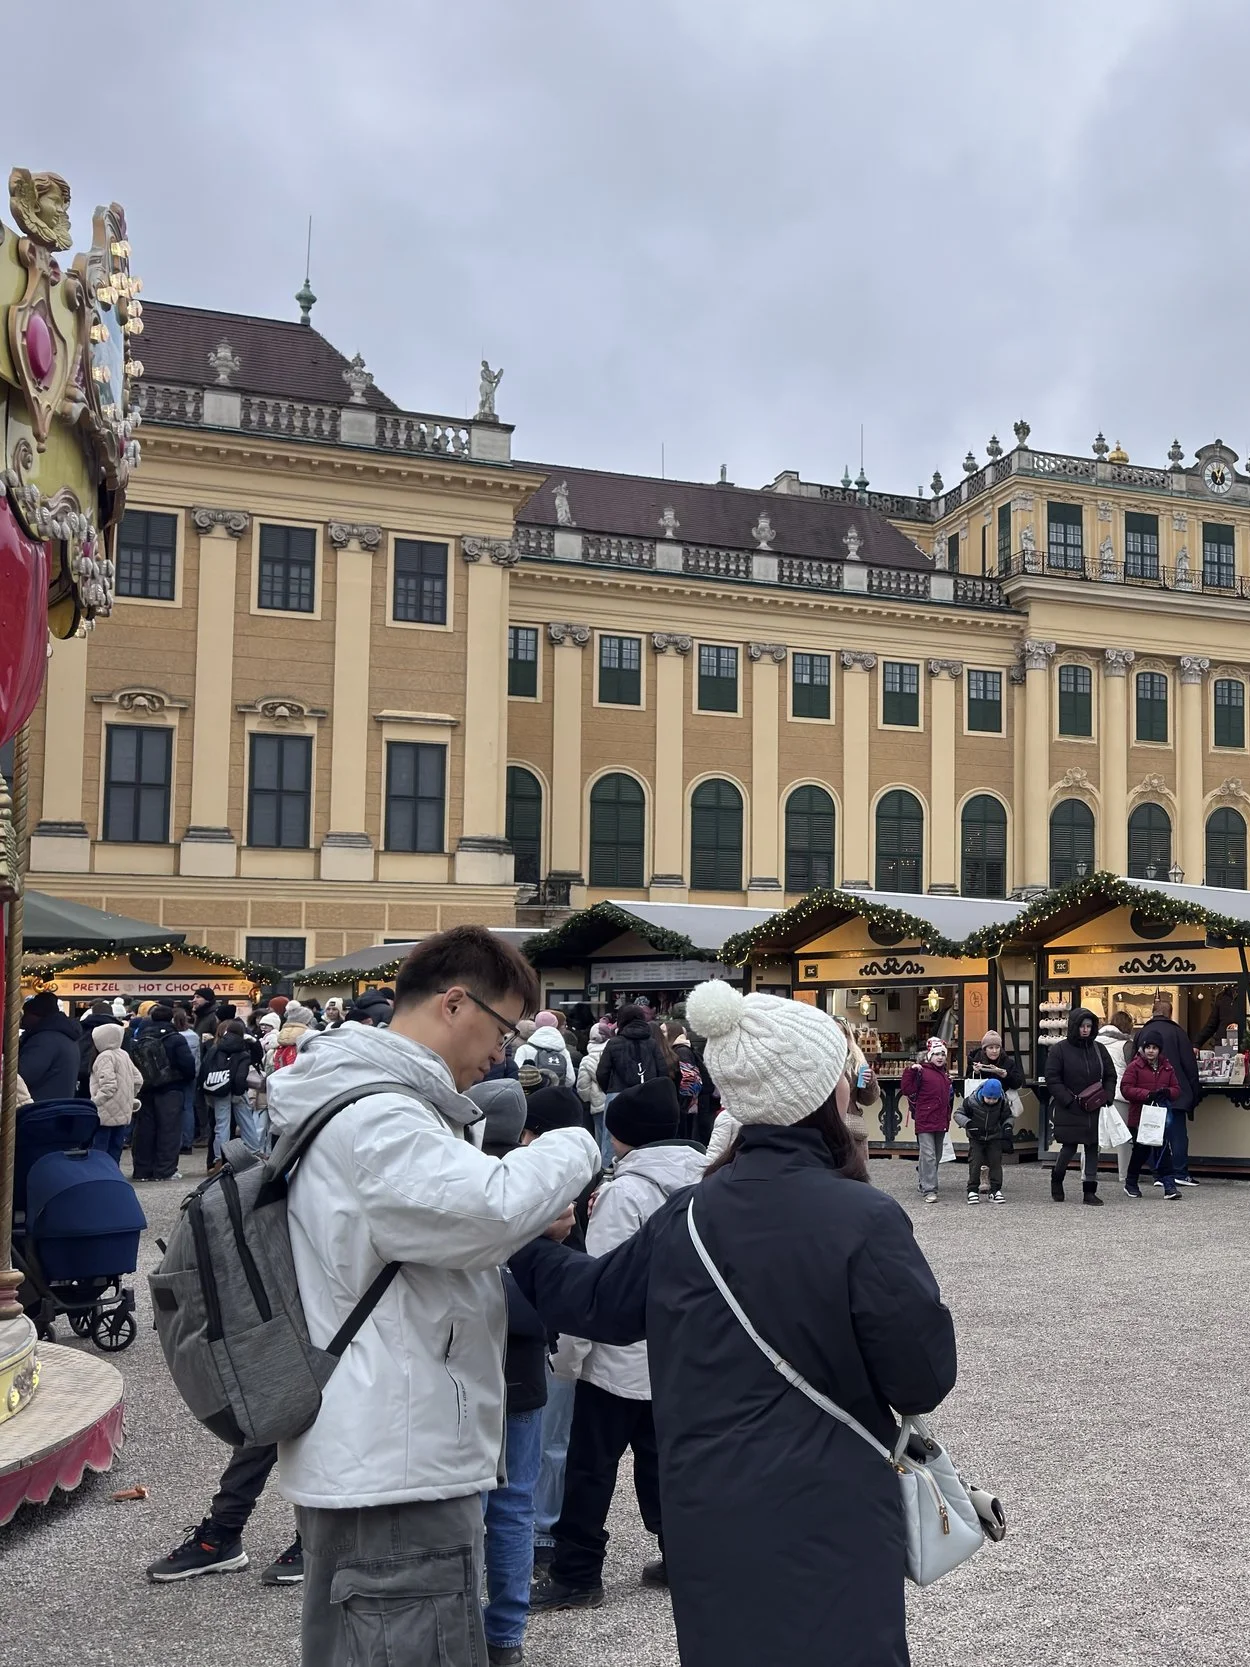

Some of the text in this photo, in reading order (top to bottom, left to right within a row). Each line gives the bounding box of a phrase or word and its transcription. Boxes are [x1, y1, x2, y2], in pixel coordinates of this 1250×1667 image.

[73, 982, 119, 992] PRETZEL
[139, 983, 161, 992] HOT
[206, 1069, 230, 1085] NIKE
